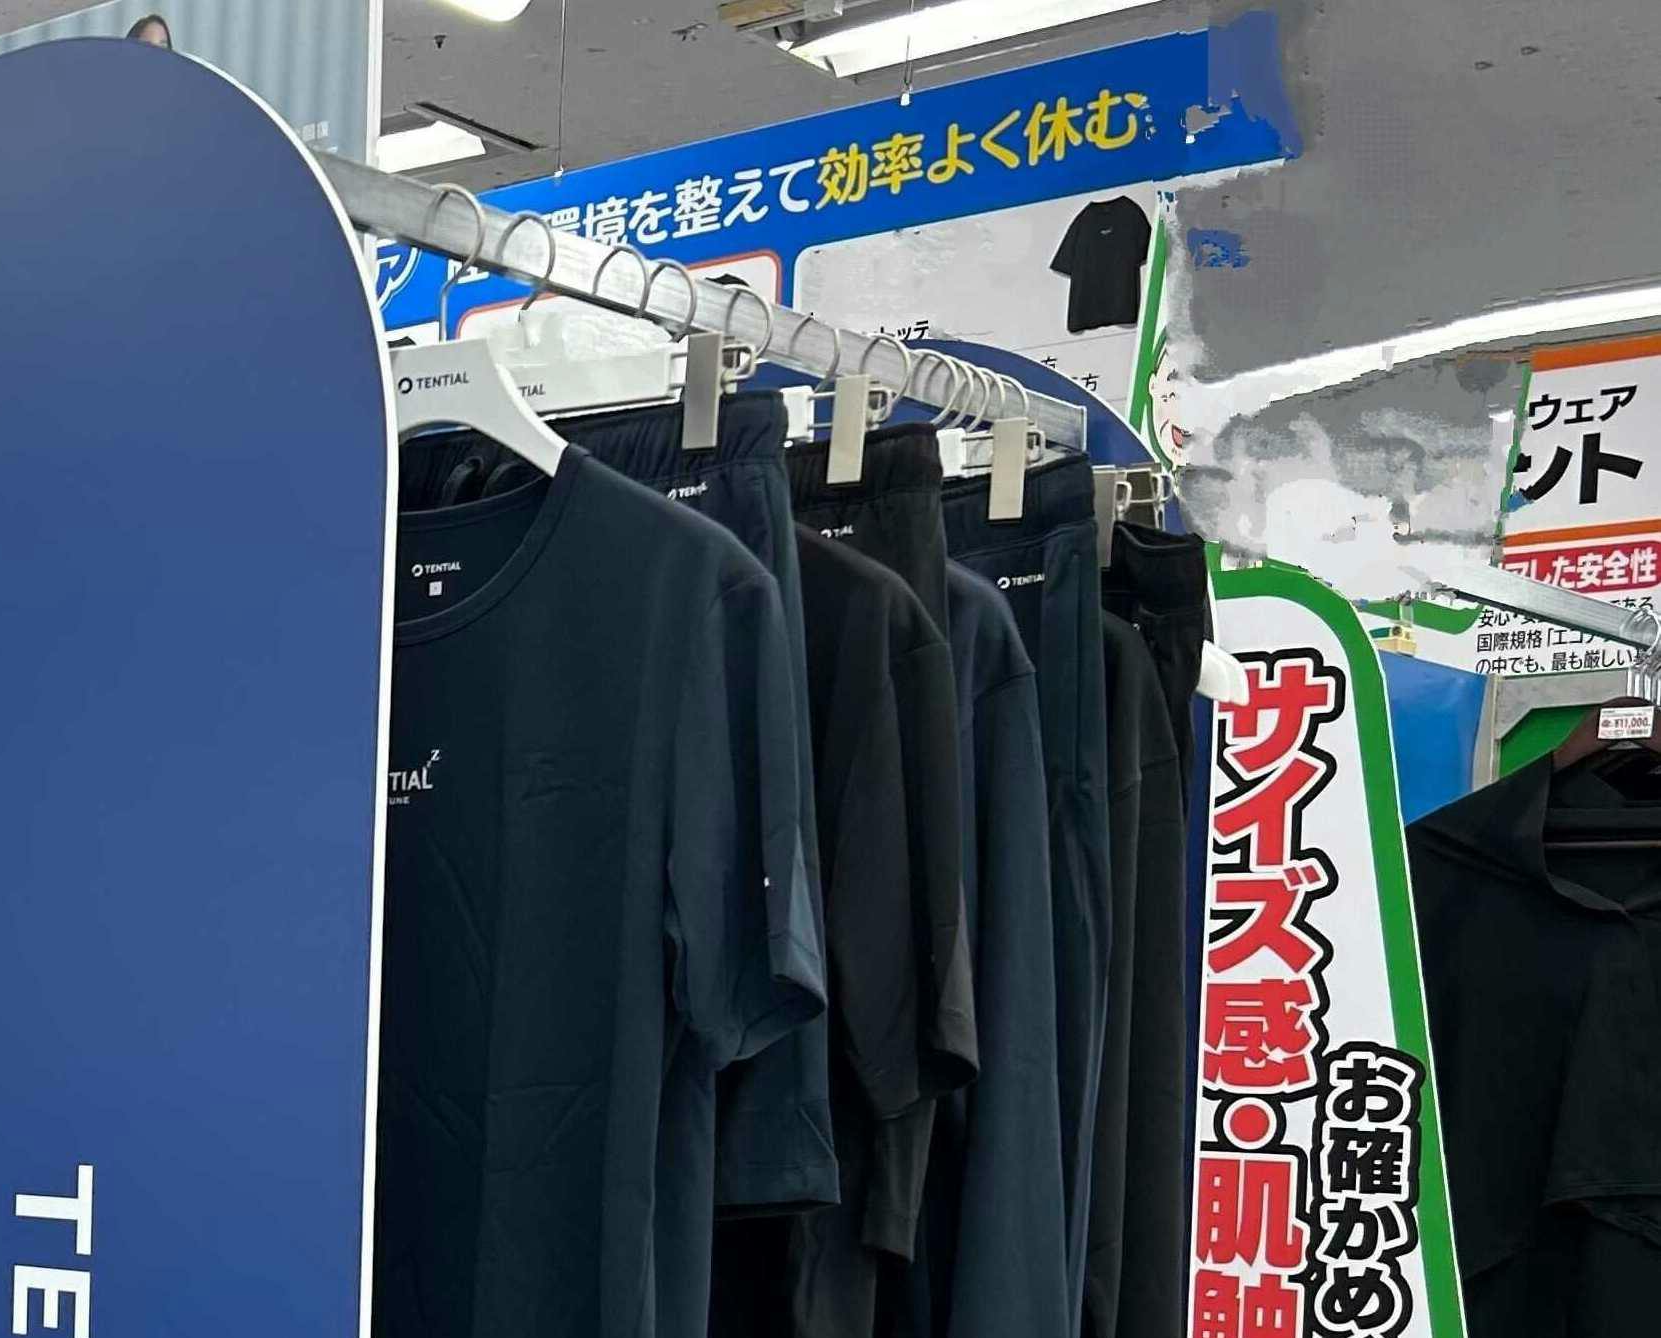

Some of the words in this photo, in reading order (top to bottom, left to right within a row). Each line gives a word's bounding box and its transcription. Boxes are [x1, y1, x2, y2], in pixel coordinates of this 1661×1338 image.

[416, 371, 469, 390] TENTIAL
[1528, 384, 1638, 430] ウェア
[424, 562, 461, 575] TENTIAL
